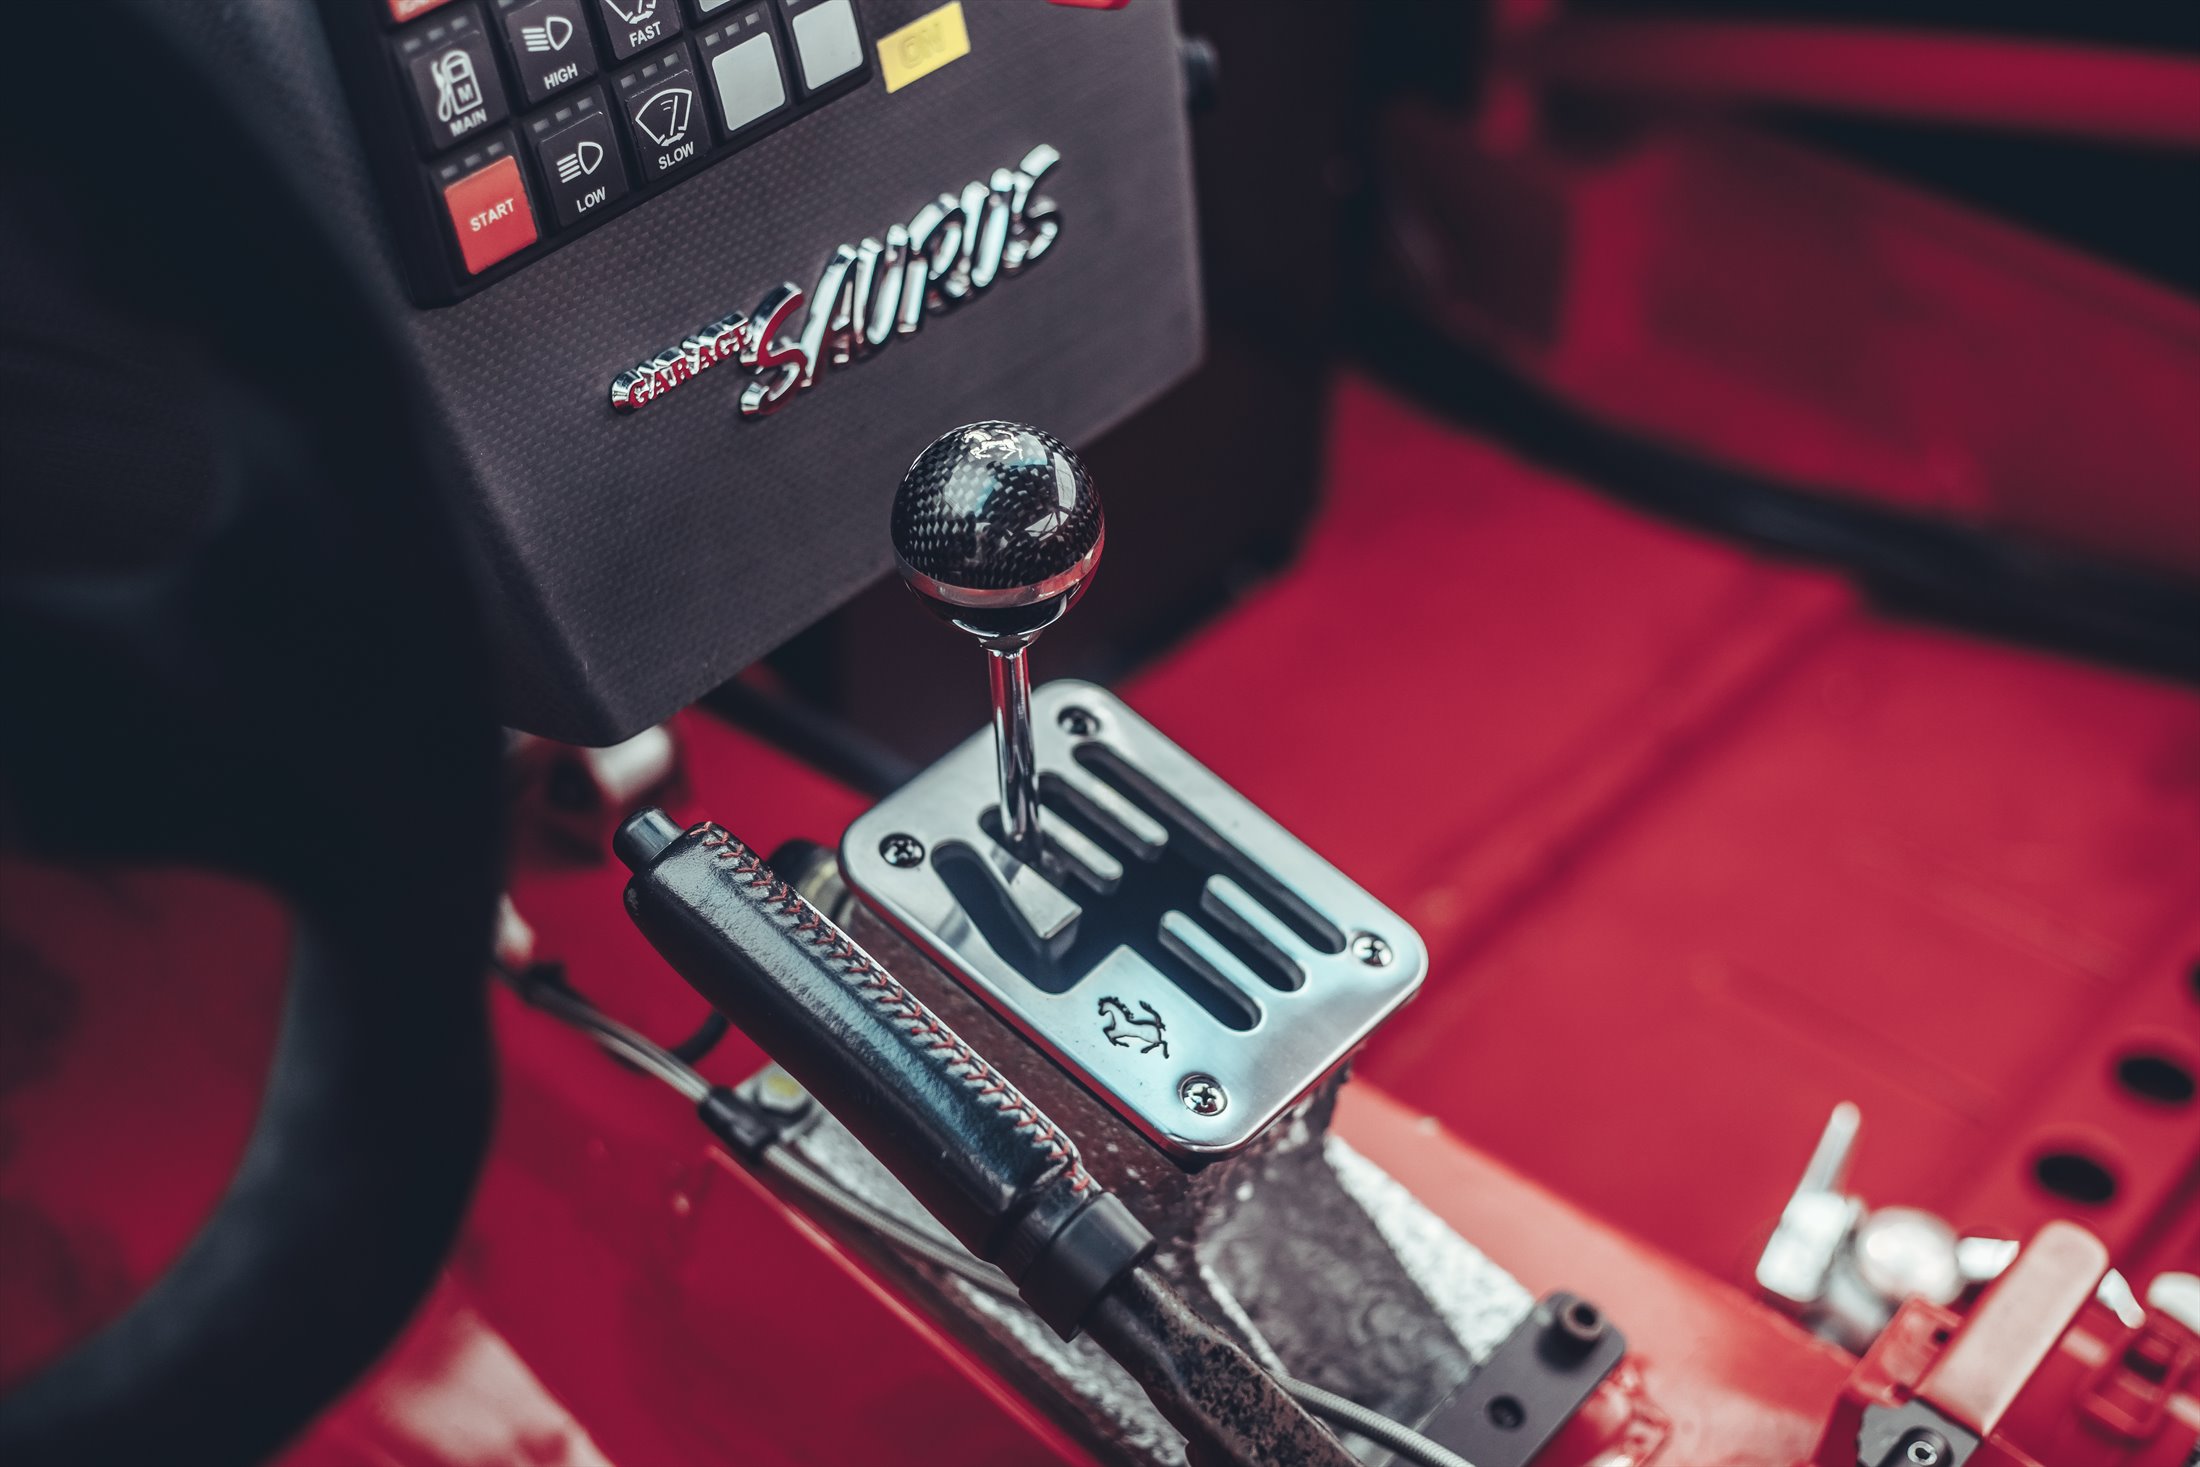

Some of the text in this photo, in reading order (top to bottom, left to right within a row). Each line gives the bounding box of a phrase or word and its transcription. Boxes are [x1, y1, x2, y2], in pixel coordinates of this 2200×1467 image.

[628, 21, 662, 48] FAST
[543, 63, 579, 90] HIGH
[456, 84, 474, 104] M
[450, 109, 488, 137] MAIN
[658, 141, 695, 170] SLOW
[576, 186, 607, 213] LOW
[469, 198, 515, 232] START
[612, 311, 752, 410] GARAGE
